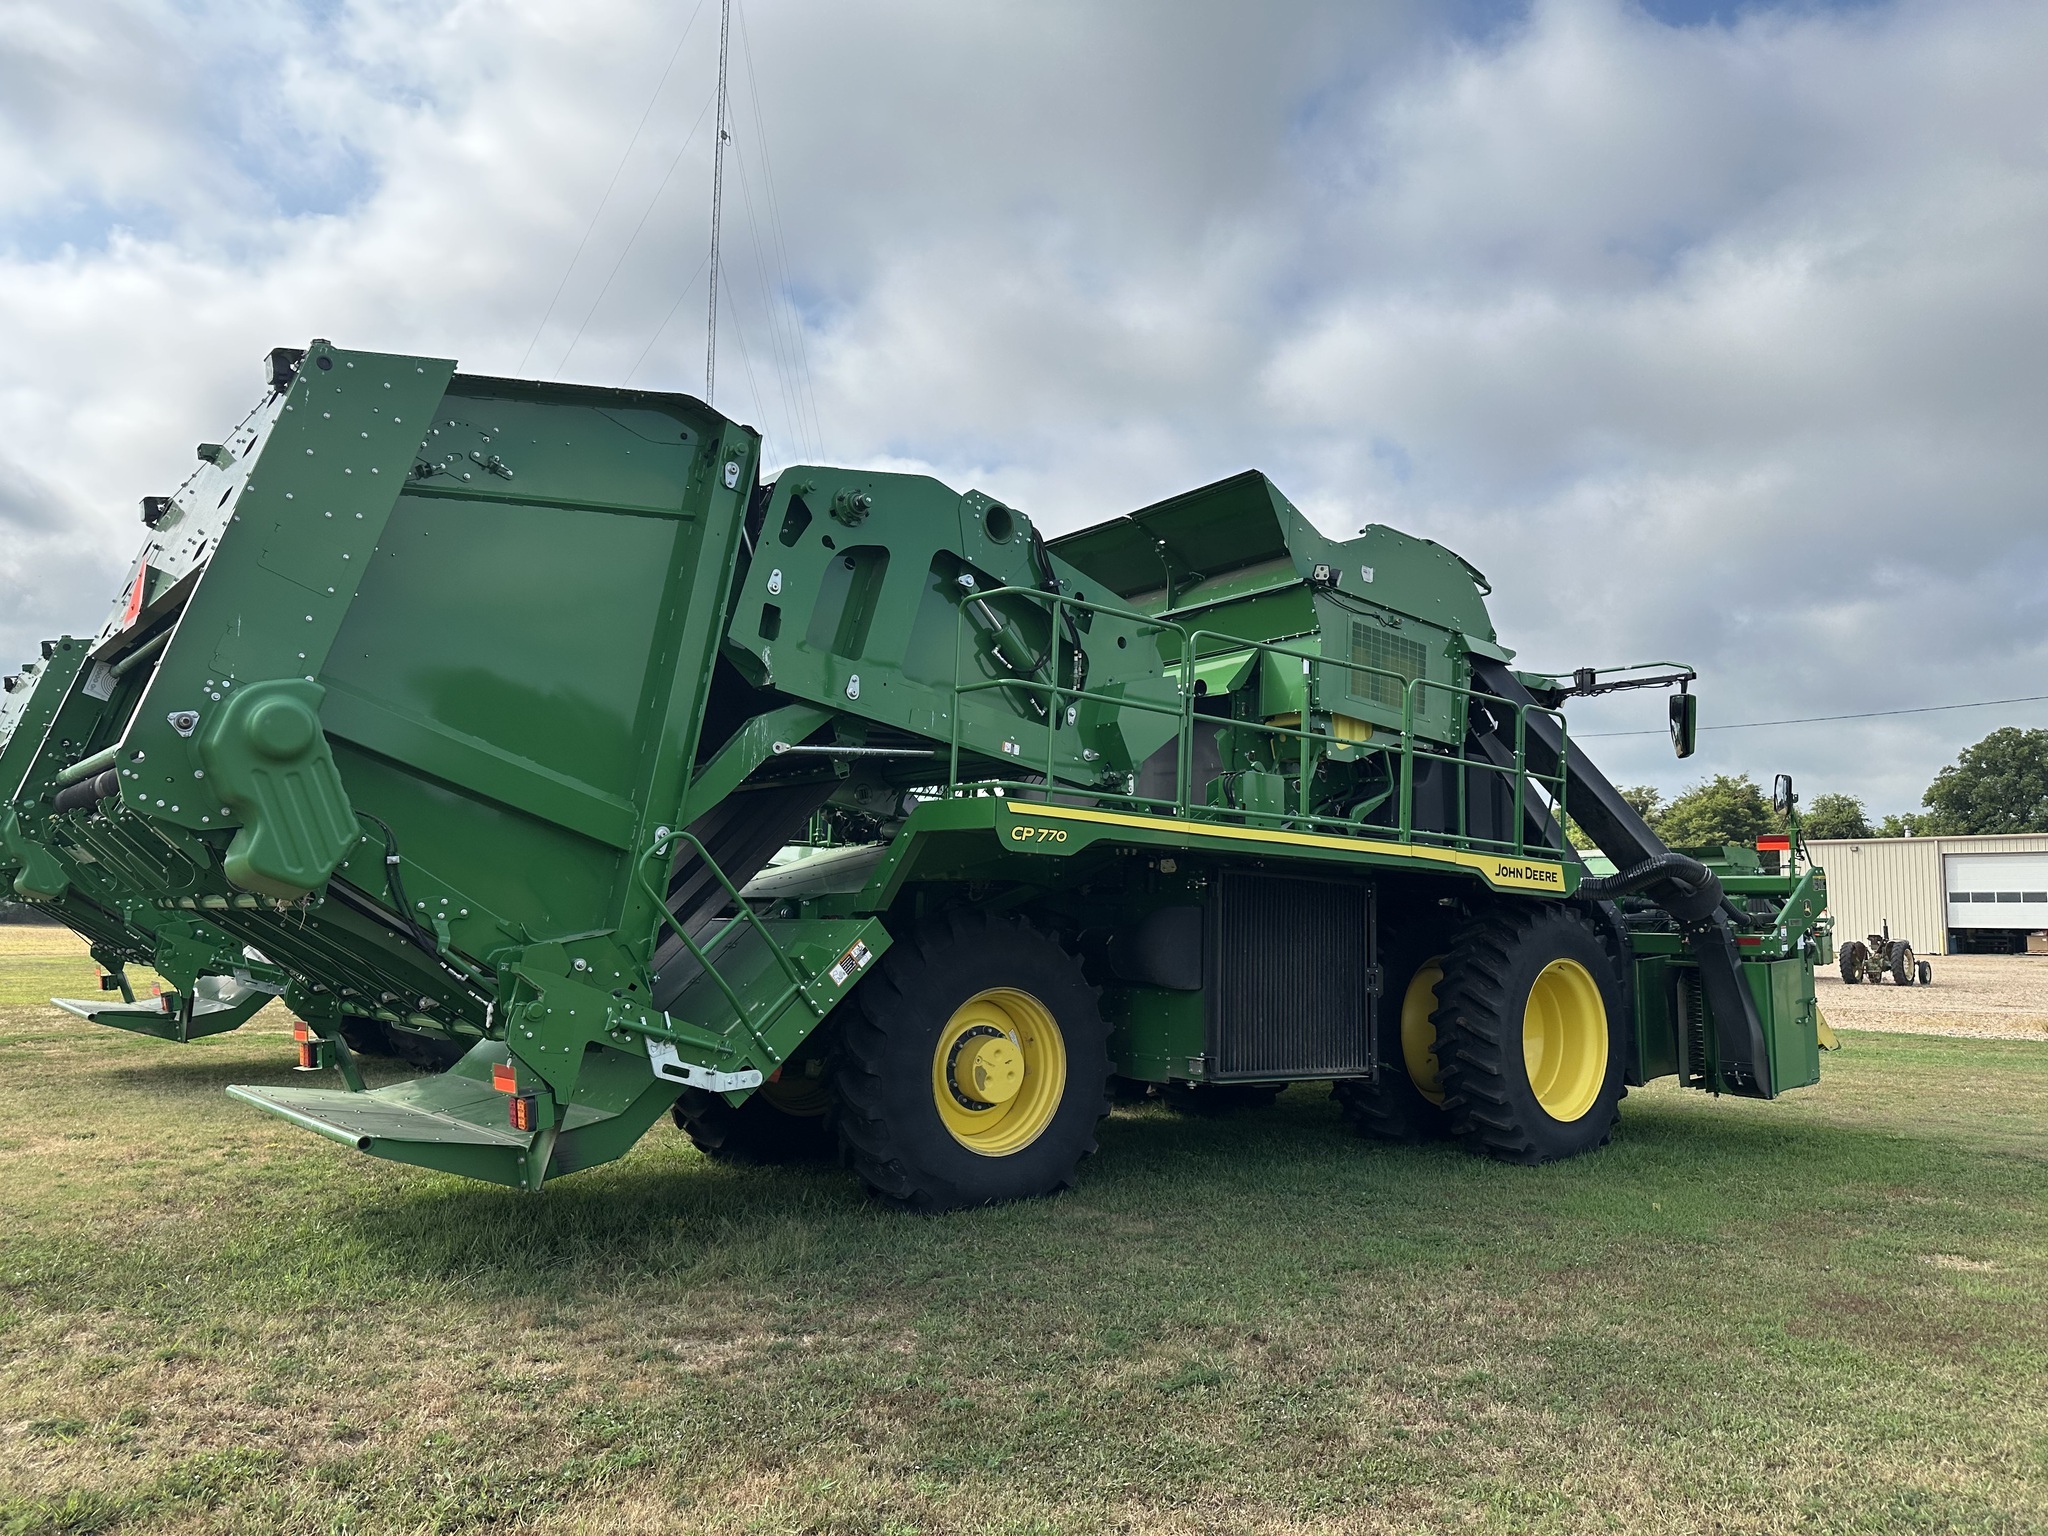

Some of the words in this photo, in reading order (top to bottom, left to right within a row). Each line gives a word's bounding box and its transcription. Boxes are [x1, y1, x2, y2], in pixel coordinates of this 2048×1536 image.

[1011, 825, 1035, 841] CP
[1036, 828, 1068, 843] 770
[1495, 863, 1523, 879] JOHN
[1525, 866, 1558, 883] DEERE
